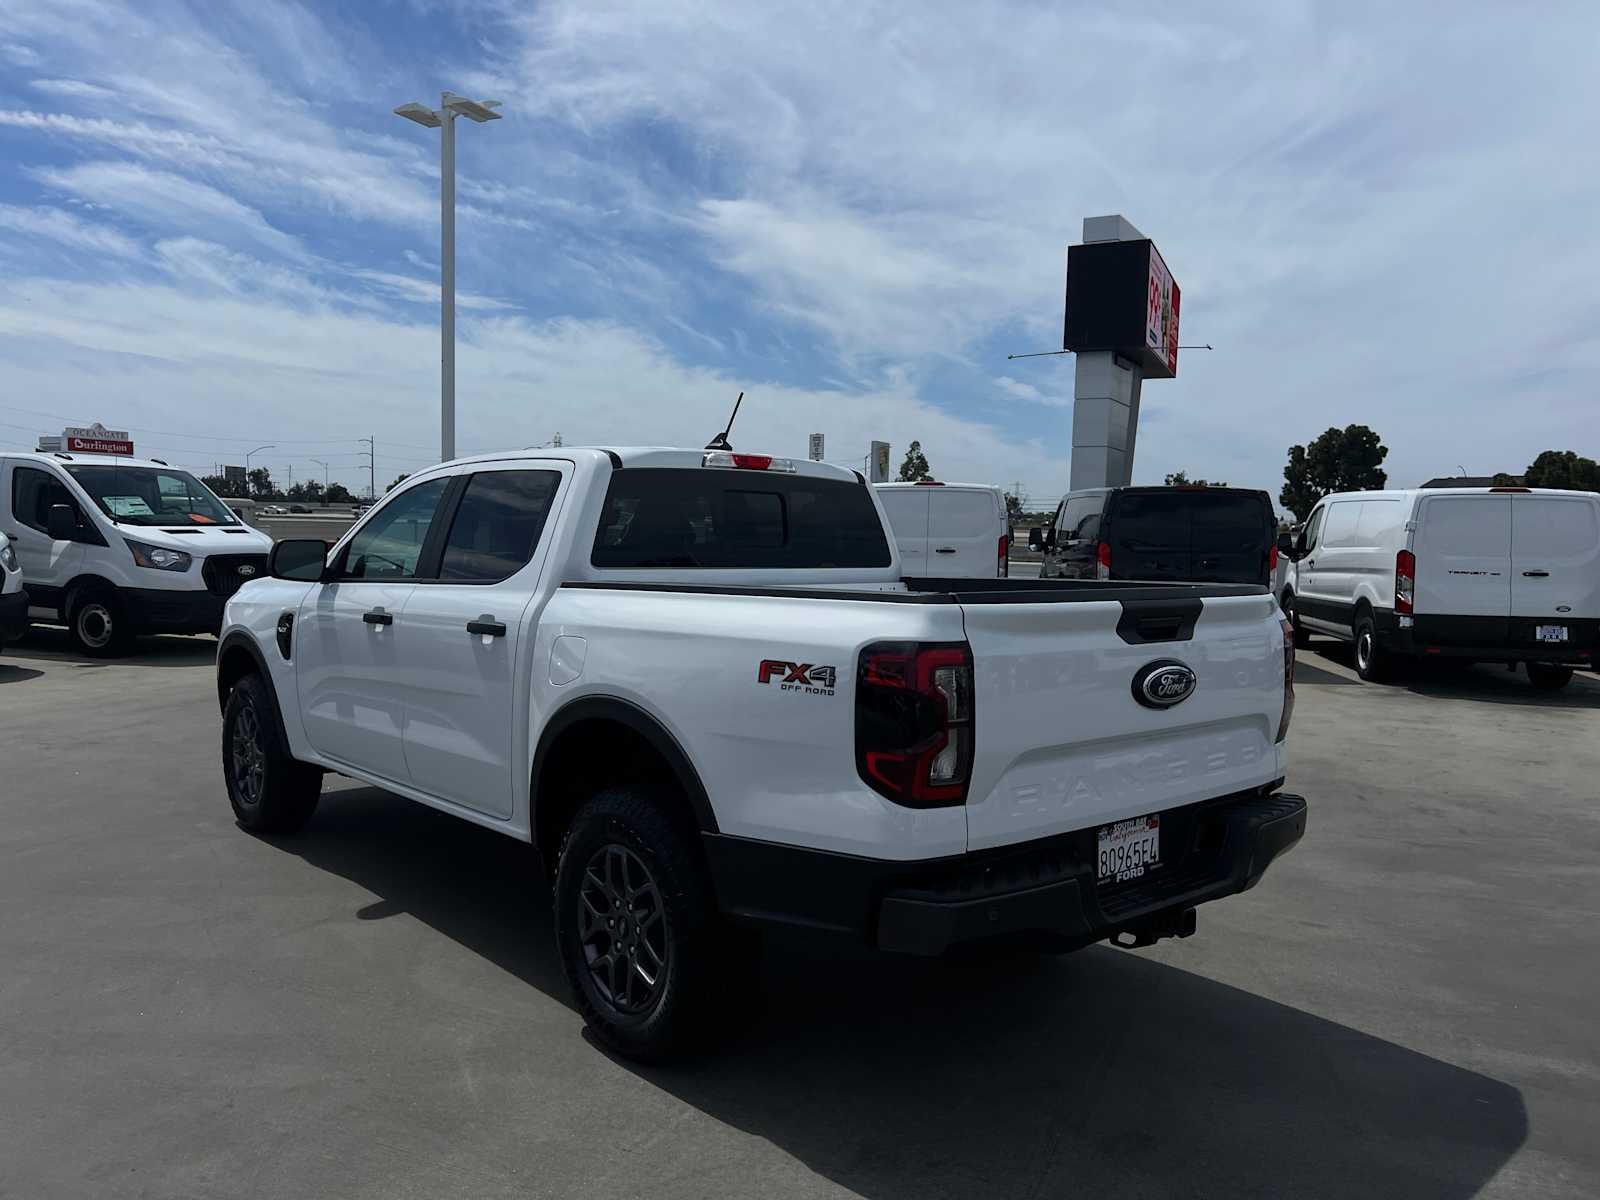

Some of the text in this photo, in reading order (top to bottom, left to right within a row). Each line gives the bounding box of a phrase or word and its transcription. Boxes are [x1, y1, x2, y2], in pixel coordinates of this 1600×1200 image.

[74, 438, 128, 452] Burlington
[758, 659, 837, 688] FX4
[780, 683, 835, 697] OFF ROAD
[1158, 673, 1187, 696] Ford
[1100, 836, 1158, 877] 80965E4
[1116, 865, 1145, 884] FORD
